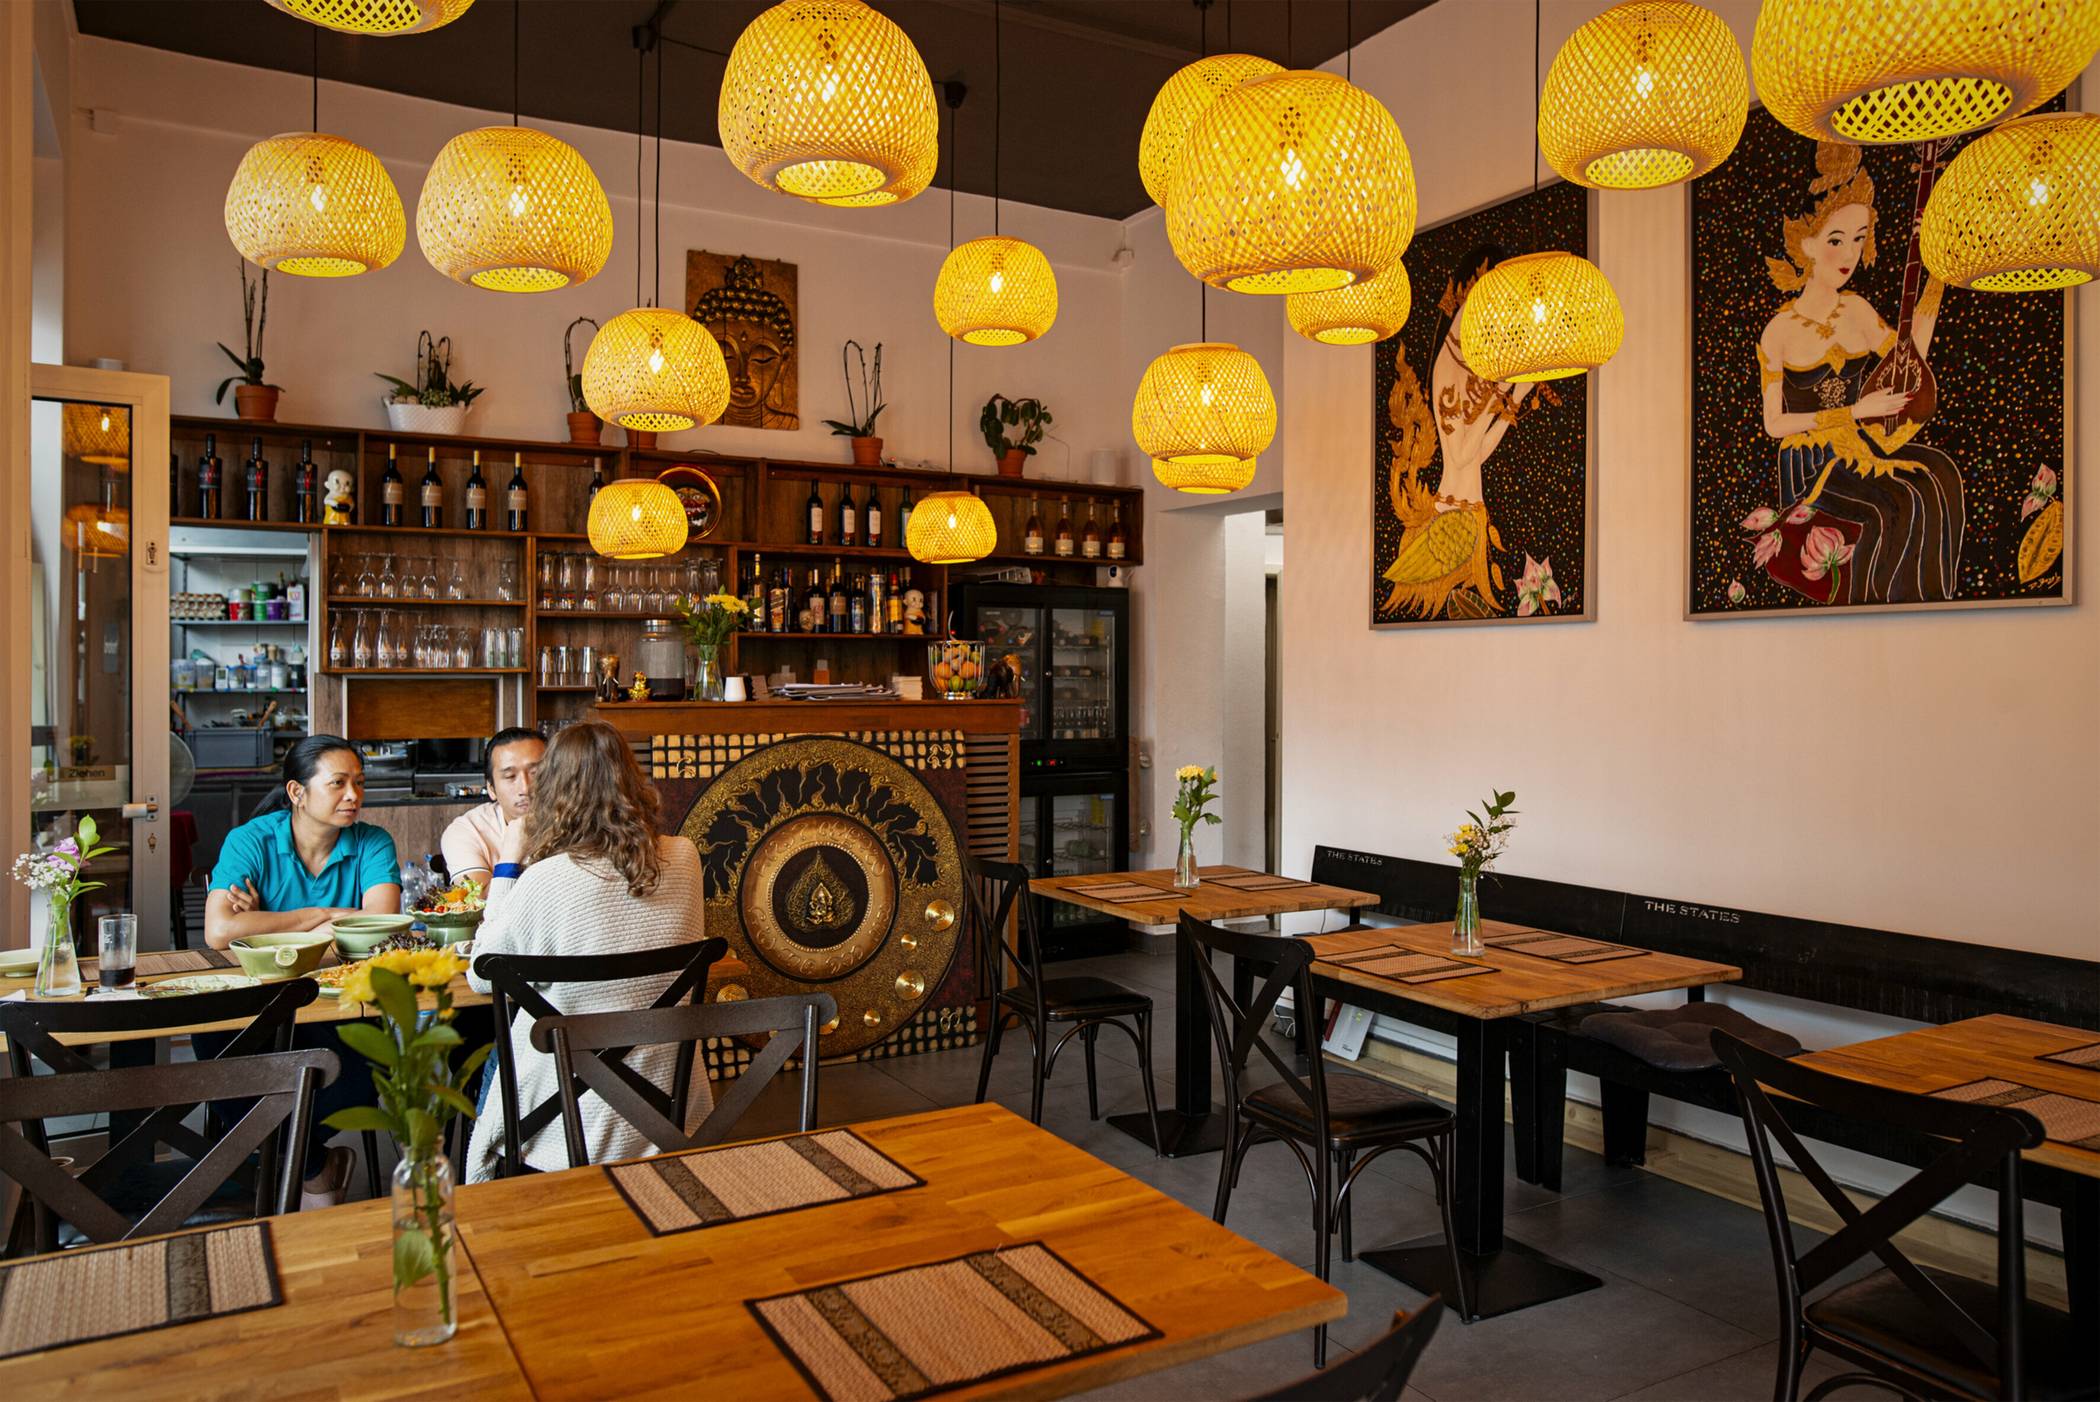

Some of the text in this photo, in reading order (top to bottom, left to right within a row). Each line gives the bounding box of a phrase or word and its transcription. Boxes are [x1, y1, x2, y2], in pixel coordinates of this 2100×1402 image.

[68, 767, 105, 778] Ziehen
[1327, 850, 1383, 866] THE STATES
[1644, 900, 1741, 924] THE STATES
